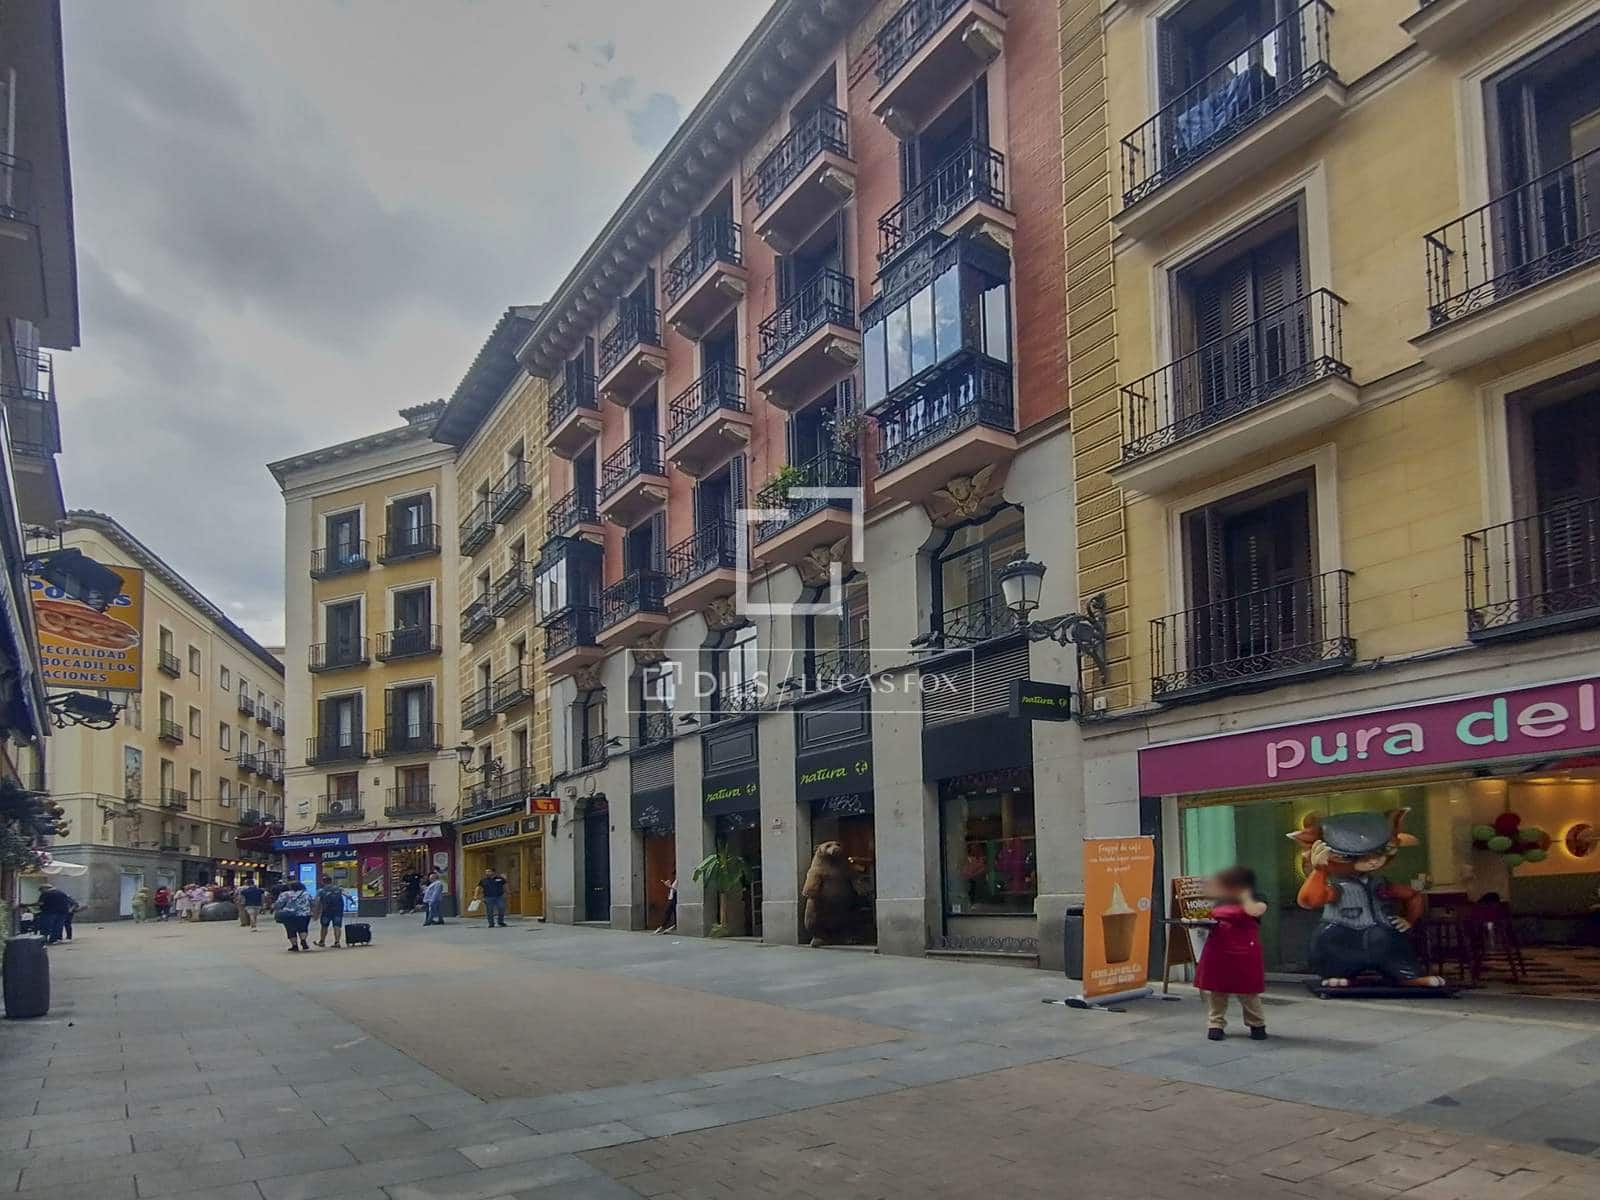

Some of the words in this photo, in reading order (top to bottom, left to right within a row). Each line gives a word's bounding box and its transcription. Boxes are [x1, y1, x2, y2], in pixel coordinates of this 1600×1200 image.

[40, 645, 127, 660] ECIALIDAD
[41, 657, 136, 672] BOCADILLOS
[42, 670, 108, 682] ACIONES
[1021, 694, 1055, 706] natura
[1265, 721, 1424, 778] pura
[800, 765, 849, 785] natura
[705, 788, 742, 803] natura
[282, 839, 312, 848] Change
[313, 837, 341, 847] Money
